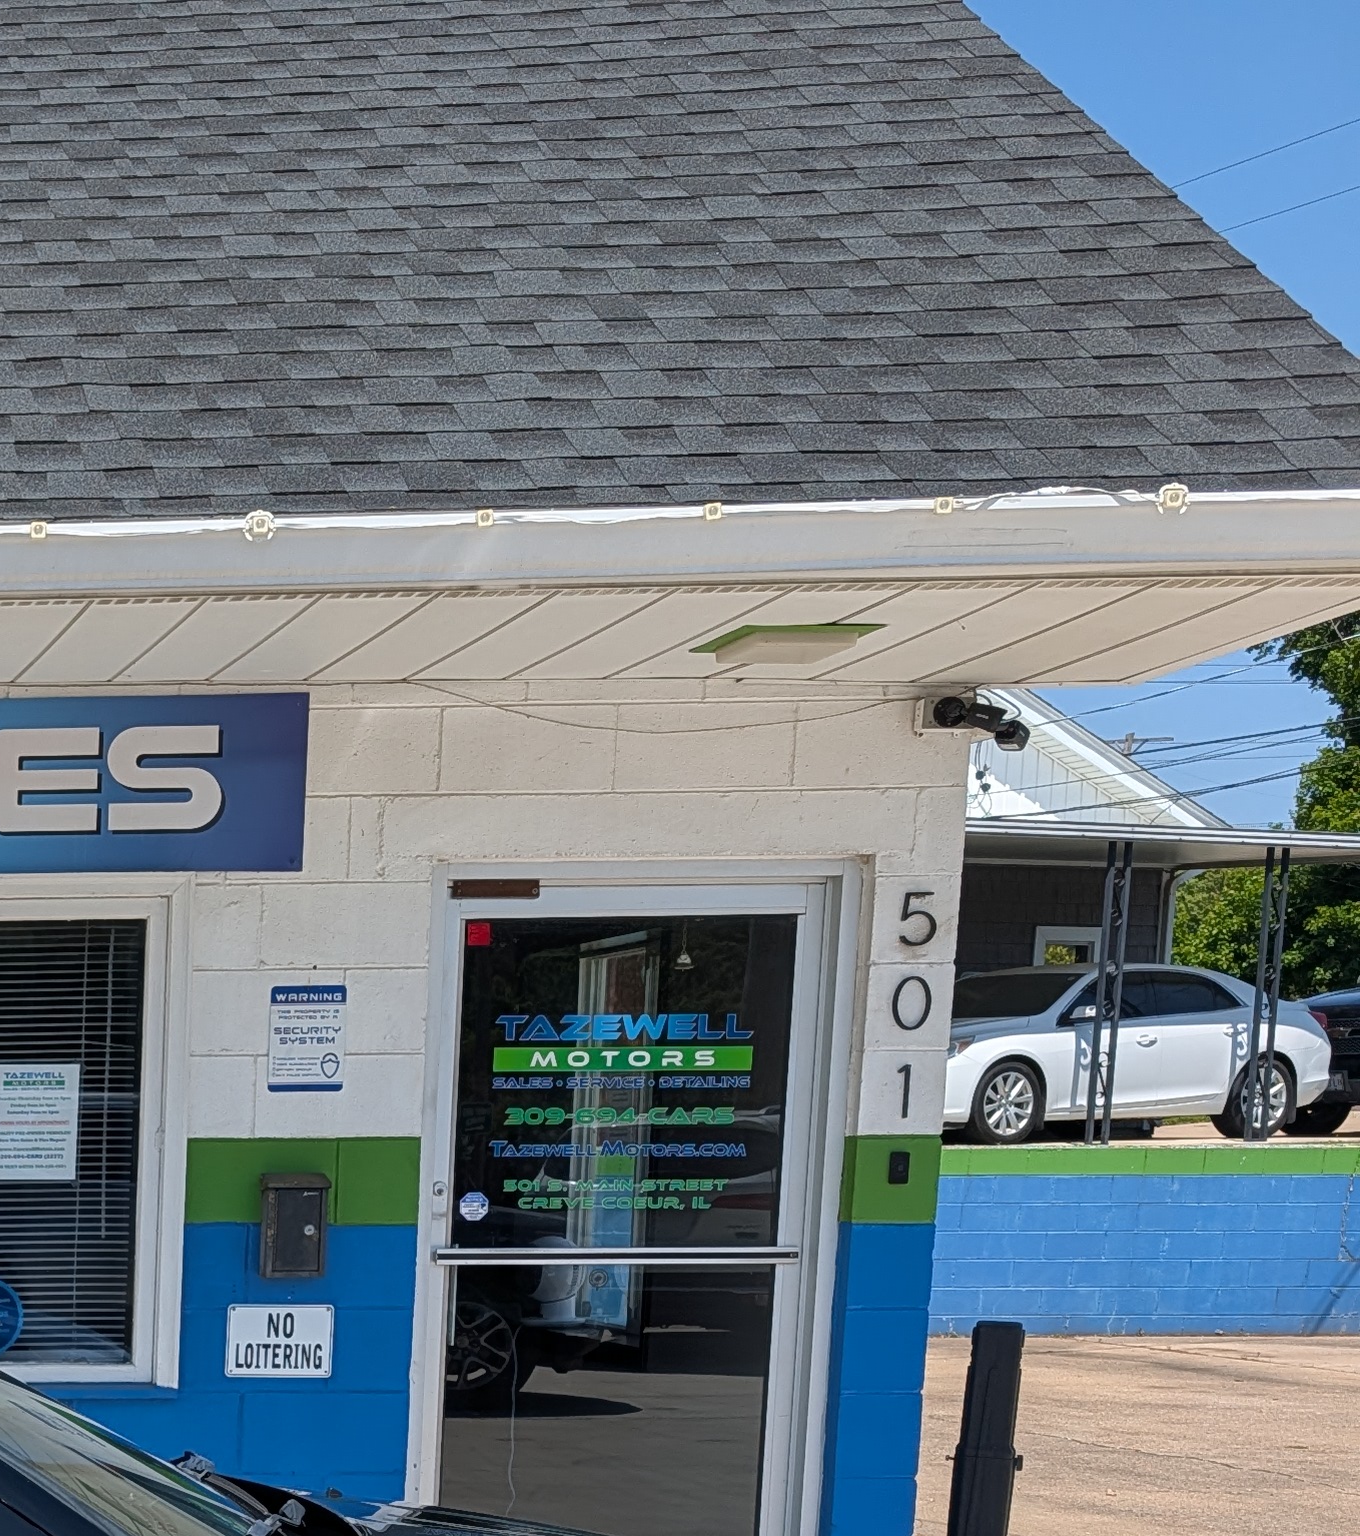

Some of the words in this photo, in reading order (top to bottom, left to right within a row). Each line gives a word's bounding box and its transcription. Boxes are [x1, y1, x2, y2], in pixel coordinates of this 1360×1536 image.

[275, 992, 343, 1002] WARNING
[892, 891, 937, 1119] 501
[273, 1026, 342, 1035] SECURITY
[495, 1014, 754, 1041] TAZEWELL
[279, 1036, 336, 1045] SYSTEM
[530, 1050, 716, 1067] MOTORS
[492, 1077, 553, 1089] SALES
[566, 1077, 644, 1089] SERVICE
[659, 1075, 751, 1088] DETAILING
[503, 1107, 735, 1126] 309-694-CARS
[503, 1179, 540, 1192] 501
[547, 1179, 568, 1192] S.
[575, 1179, 633, 1192] MAIN
[641, 1179, 729, 1191] STREET
[518, 1197, 595, 1209] CREVE
[600, 1197, 685, 1211] COEUR,
[692, 1197, 711, 1209] IL
[267, 1312, 294, 1338] NO
[235, 1343, 322, 1369] LOITERING
